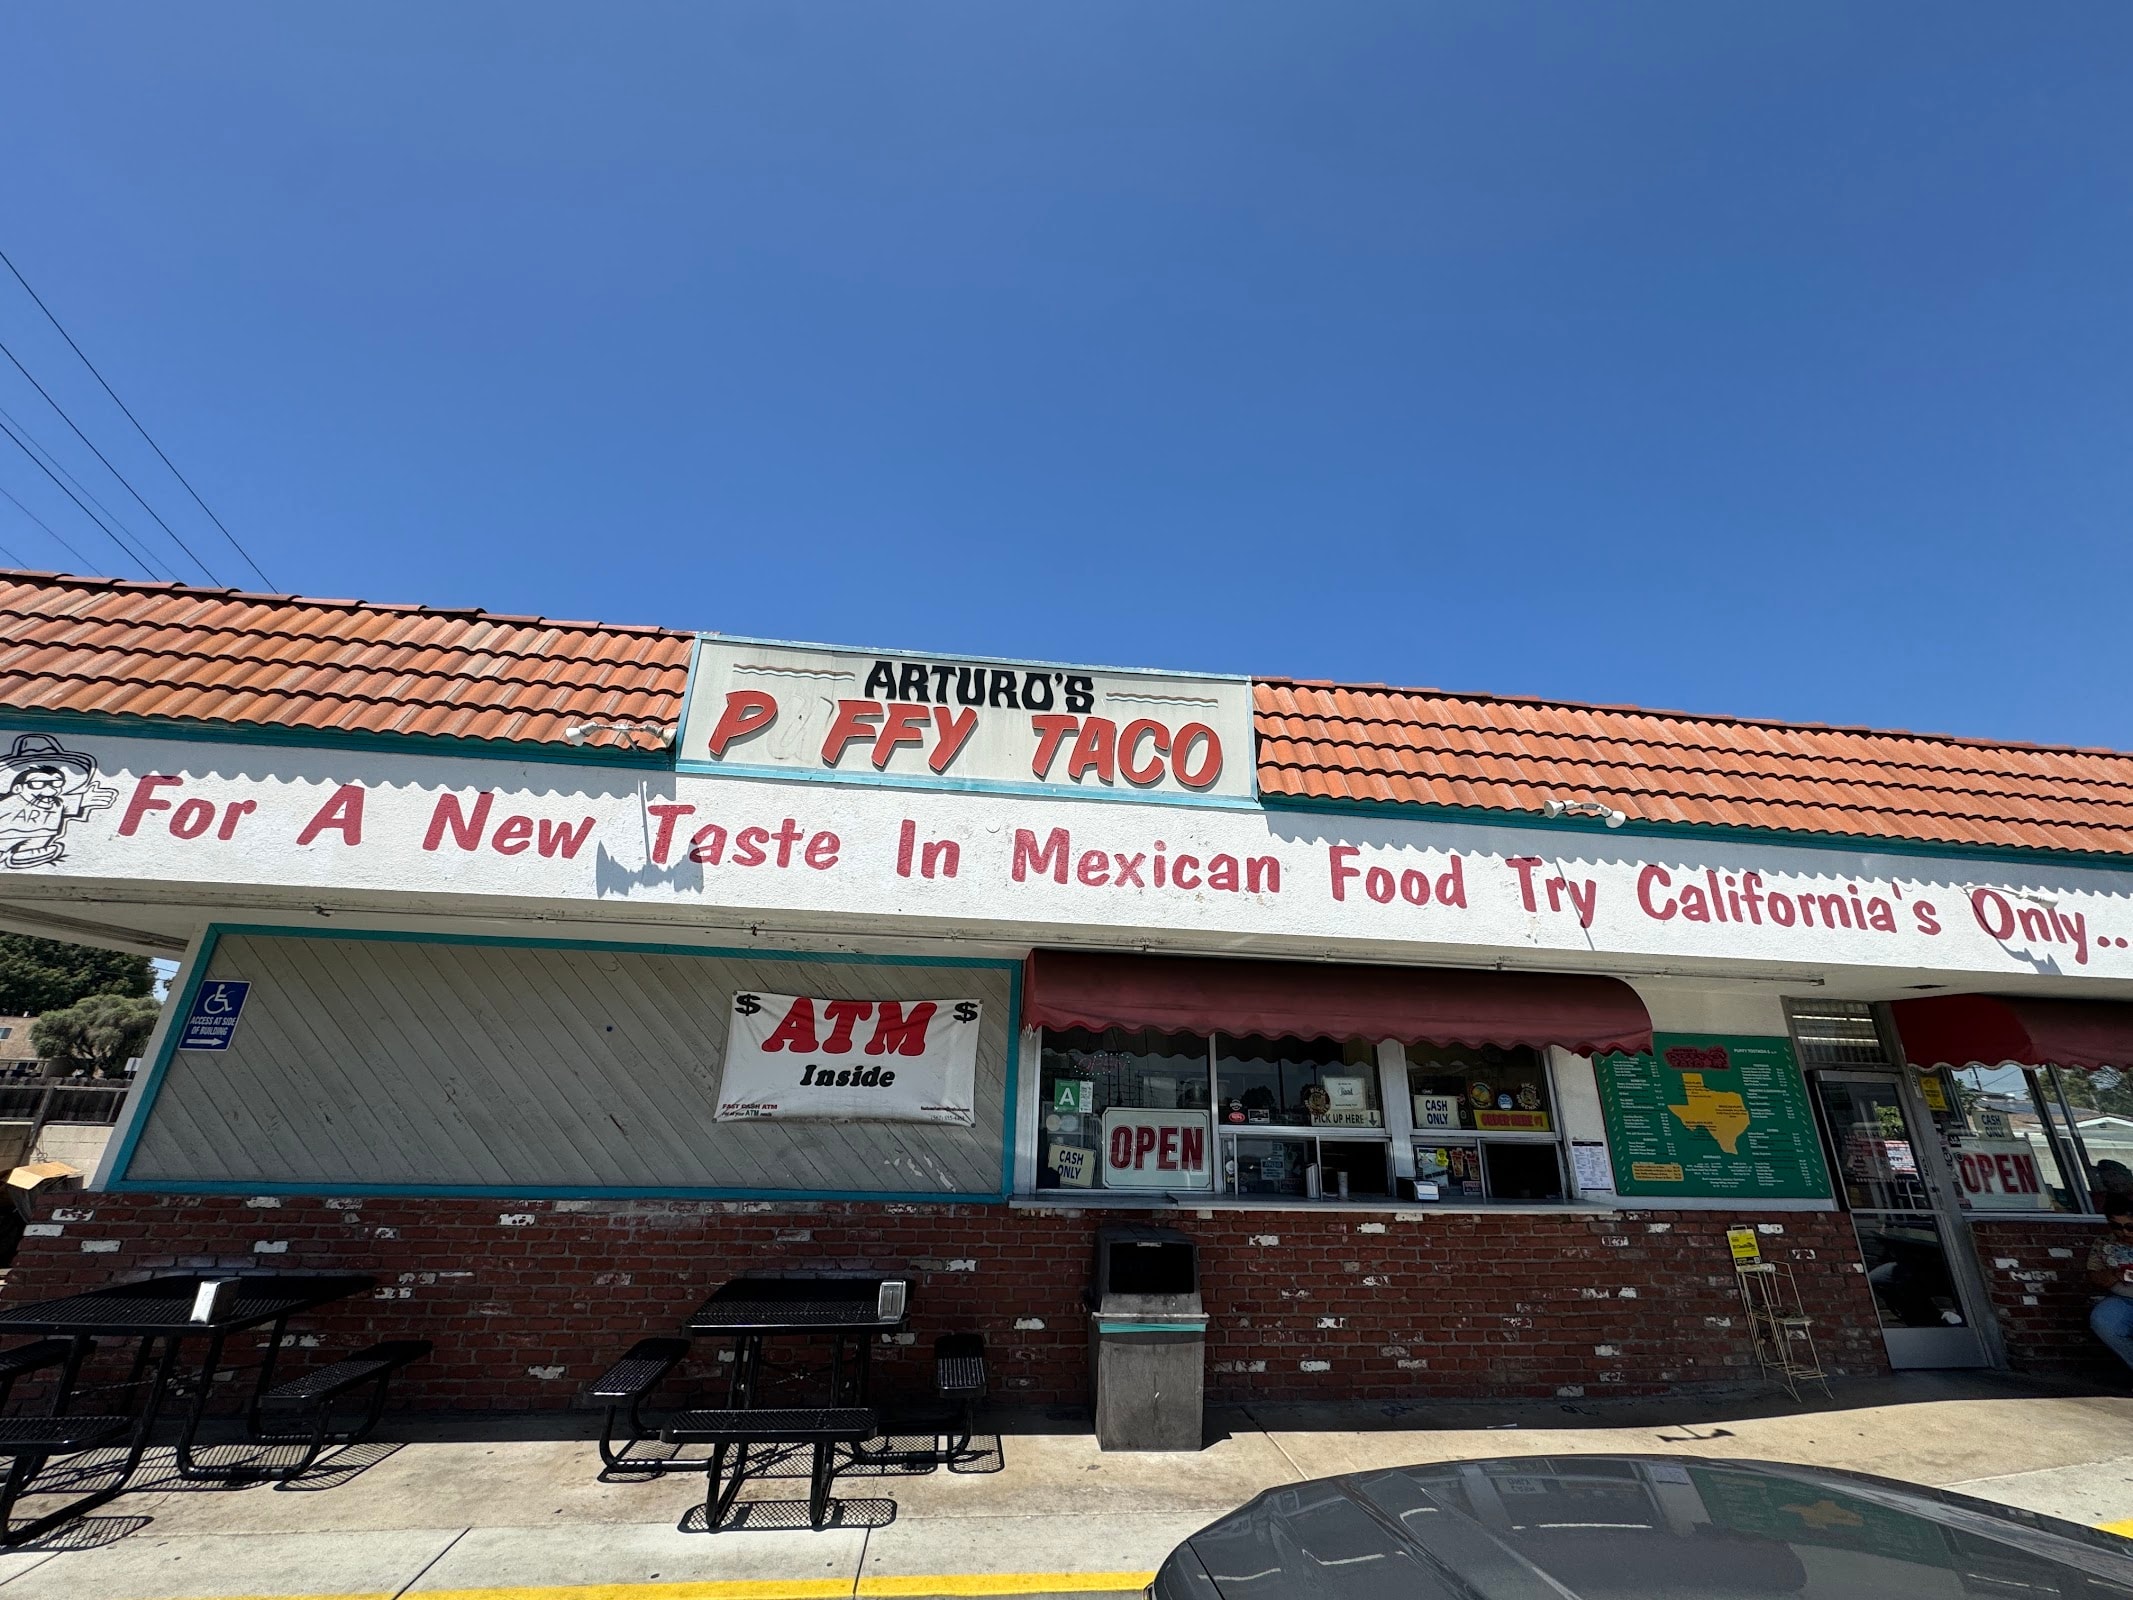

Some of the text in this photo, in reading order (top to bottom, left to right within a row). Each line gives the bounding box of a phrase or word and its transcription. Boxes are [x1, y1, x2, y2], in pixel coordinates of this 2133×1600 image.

[864, 660, 1095, 714] ARTURO'S
[1031, 713, 1224, 787] TACO
[118, 775, 256, 840] For
[297, 784, 364, 846] A
[422, 792, 596, 859] New
[648, 804, 841, 870] Taste
[897, 820, 960, 878] In
[1011, 827, 1281, 894] Mexican
[1329, 845, 1466, 908] Food
[1506, 857, 1596, 929] Try
[1637, 865, 1941, 936] California's
[190, 1016, 237, 1026] ACCESS AT SIDE
[761, 997, 938, 1057] ATM
[191, 1026, 228, 1036] OF BUILDING
[799, 1064, 896, 1087] Inside
[1059, 1087, 1075, 1106] A
[1425, 1099, 1448, 1112] CASH
[1314, 1113, 1365, 1124] PICK UP HERE
[1426, 1113, 1449, 1126] ONLY
[1981, 1114, 2002, 1126] CASH
[1108, 1124, 1205, 1172] OPEN
[1059, 1150, 1084, 1166] CASH
[1057, 1164, 1082, 1180] ONLY
[1960, 1152, 2042, 1195] OPEN
